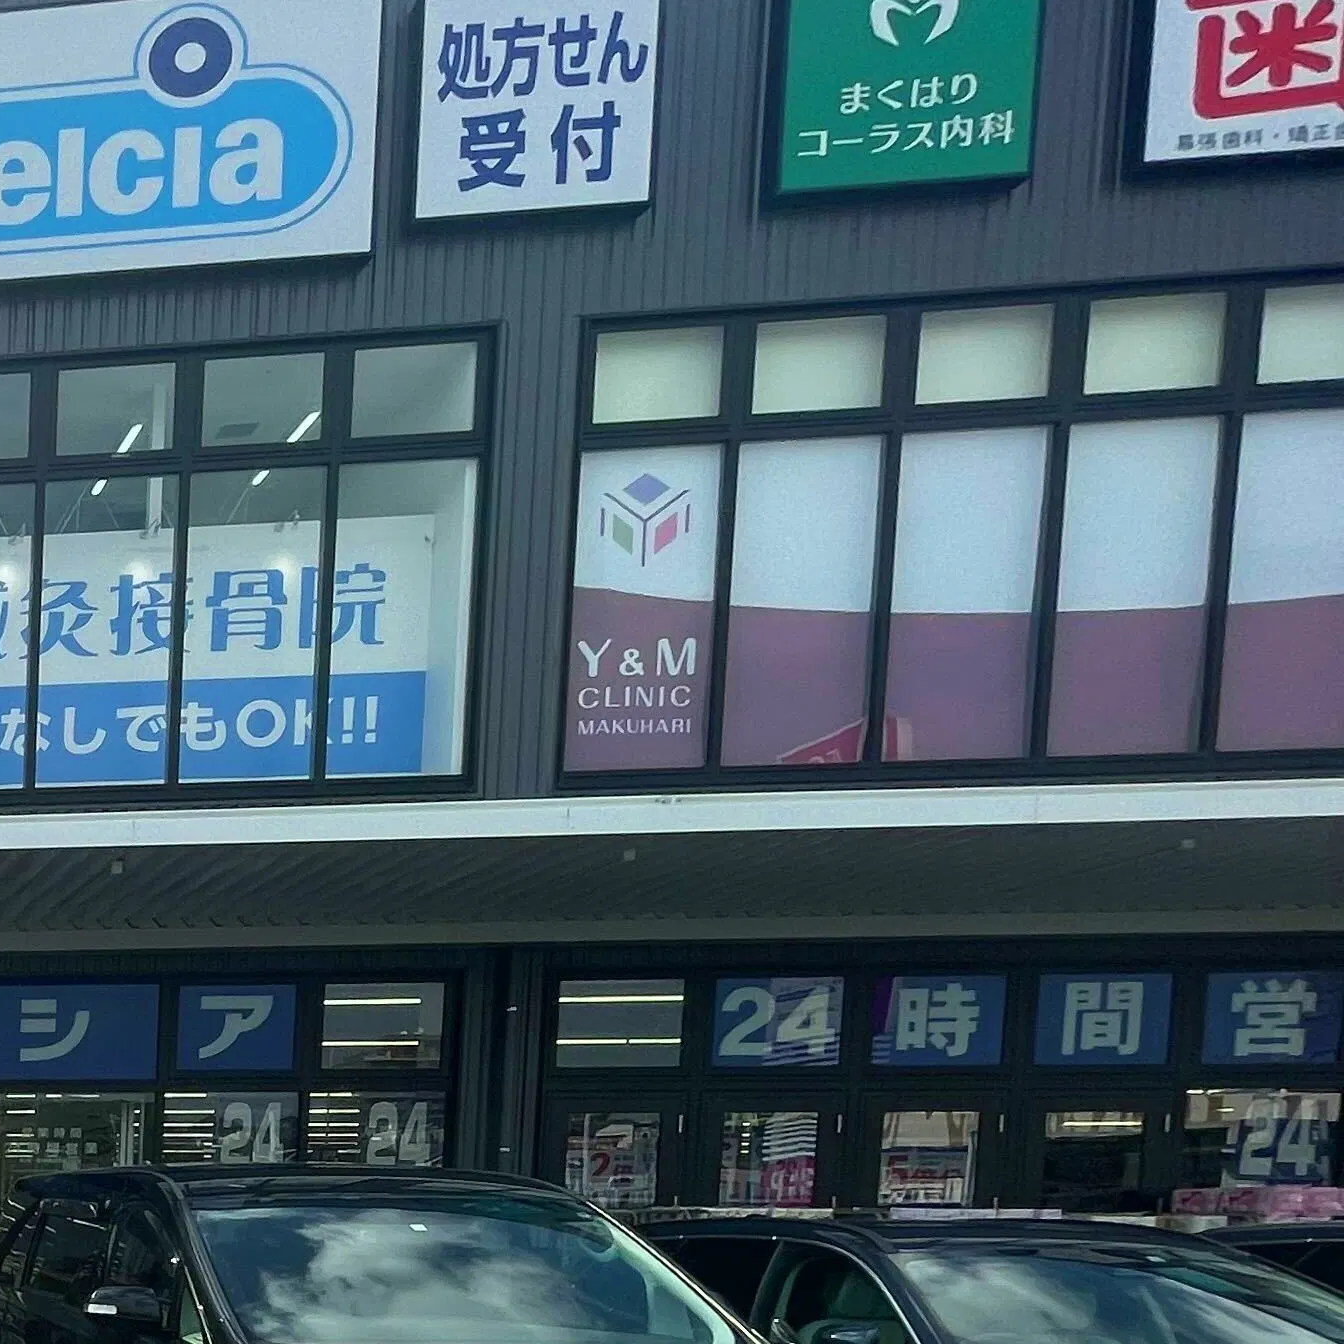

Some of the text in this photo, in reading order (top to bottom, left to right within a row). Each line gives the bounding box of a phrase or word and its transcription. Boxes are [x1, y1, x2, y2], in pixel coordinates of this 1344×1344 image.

[437, 10, 650, 103] 処方せん
[839, 72, 979, 115] まくはり
[458, 100, 622, 192] 受付
[796, 109, 1016, 157] コーラス内科
[577, 685, 691, 709] CLINIC
[577, 718, 692, 735] MAKUHARI
[220, 1101, 285, 1164] 24
[366, 1101, 432, 1165] 24
[1238, 1097, 1318, 1176] 24
